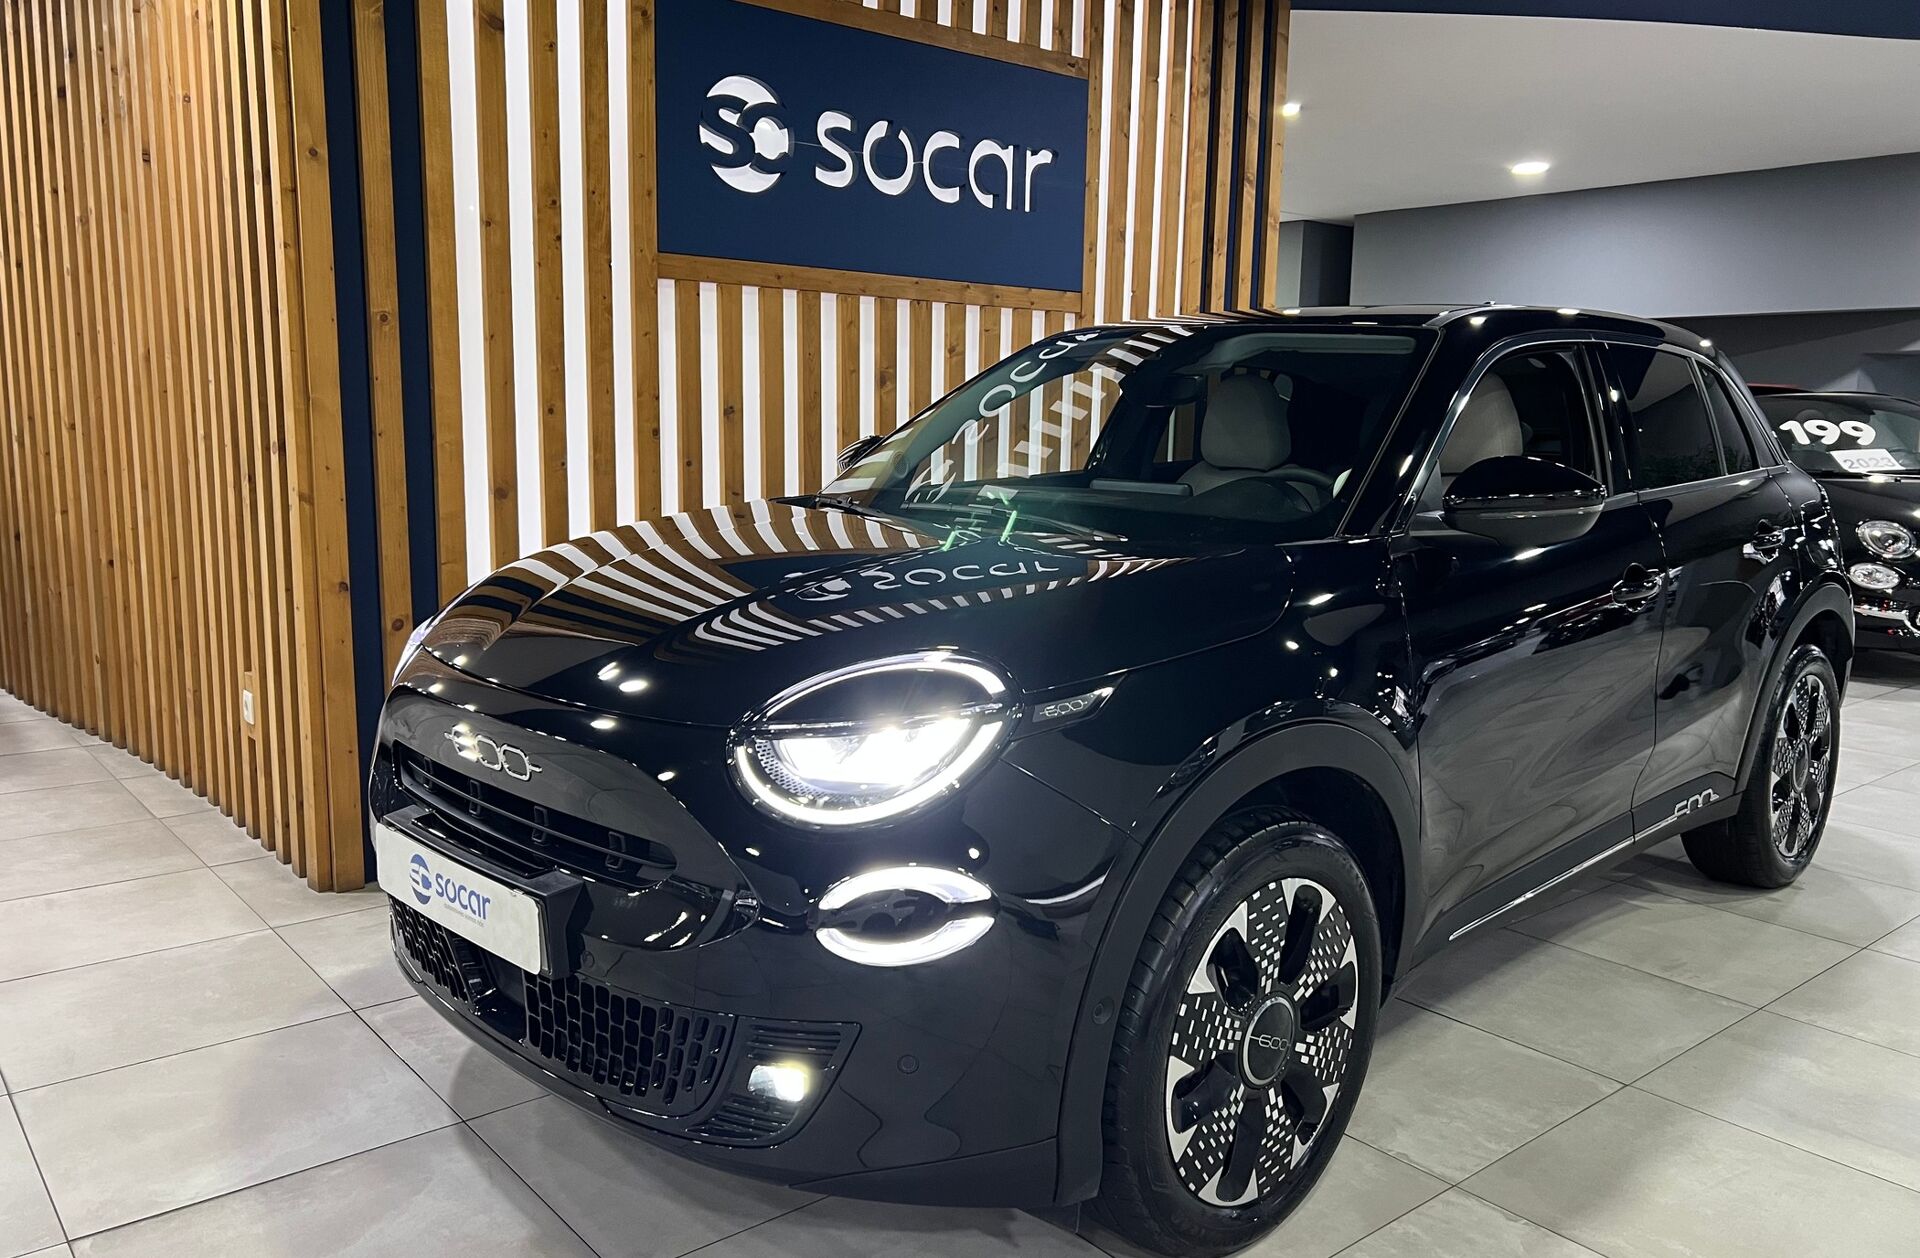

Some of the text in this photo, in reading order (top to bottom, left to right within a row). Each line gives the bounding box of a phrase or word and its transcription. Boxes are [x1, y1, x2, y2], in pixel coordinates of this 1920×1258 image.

[815, 110, 1053, 213] socar
[1779, 419, 1876, 446] 199
[1843, 457, 1896, 469] 2023
[435, 872, 492, 920] socar
[1258, 1033, 1289, 1052] 600
